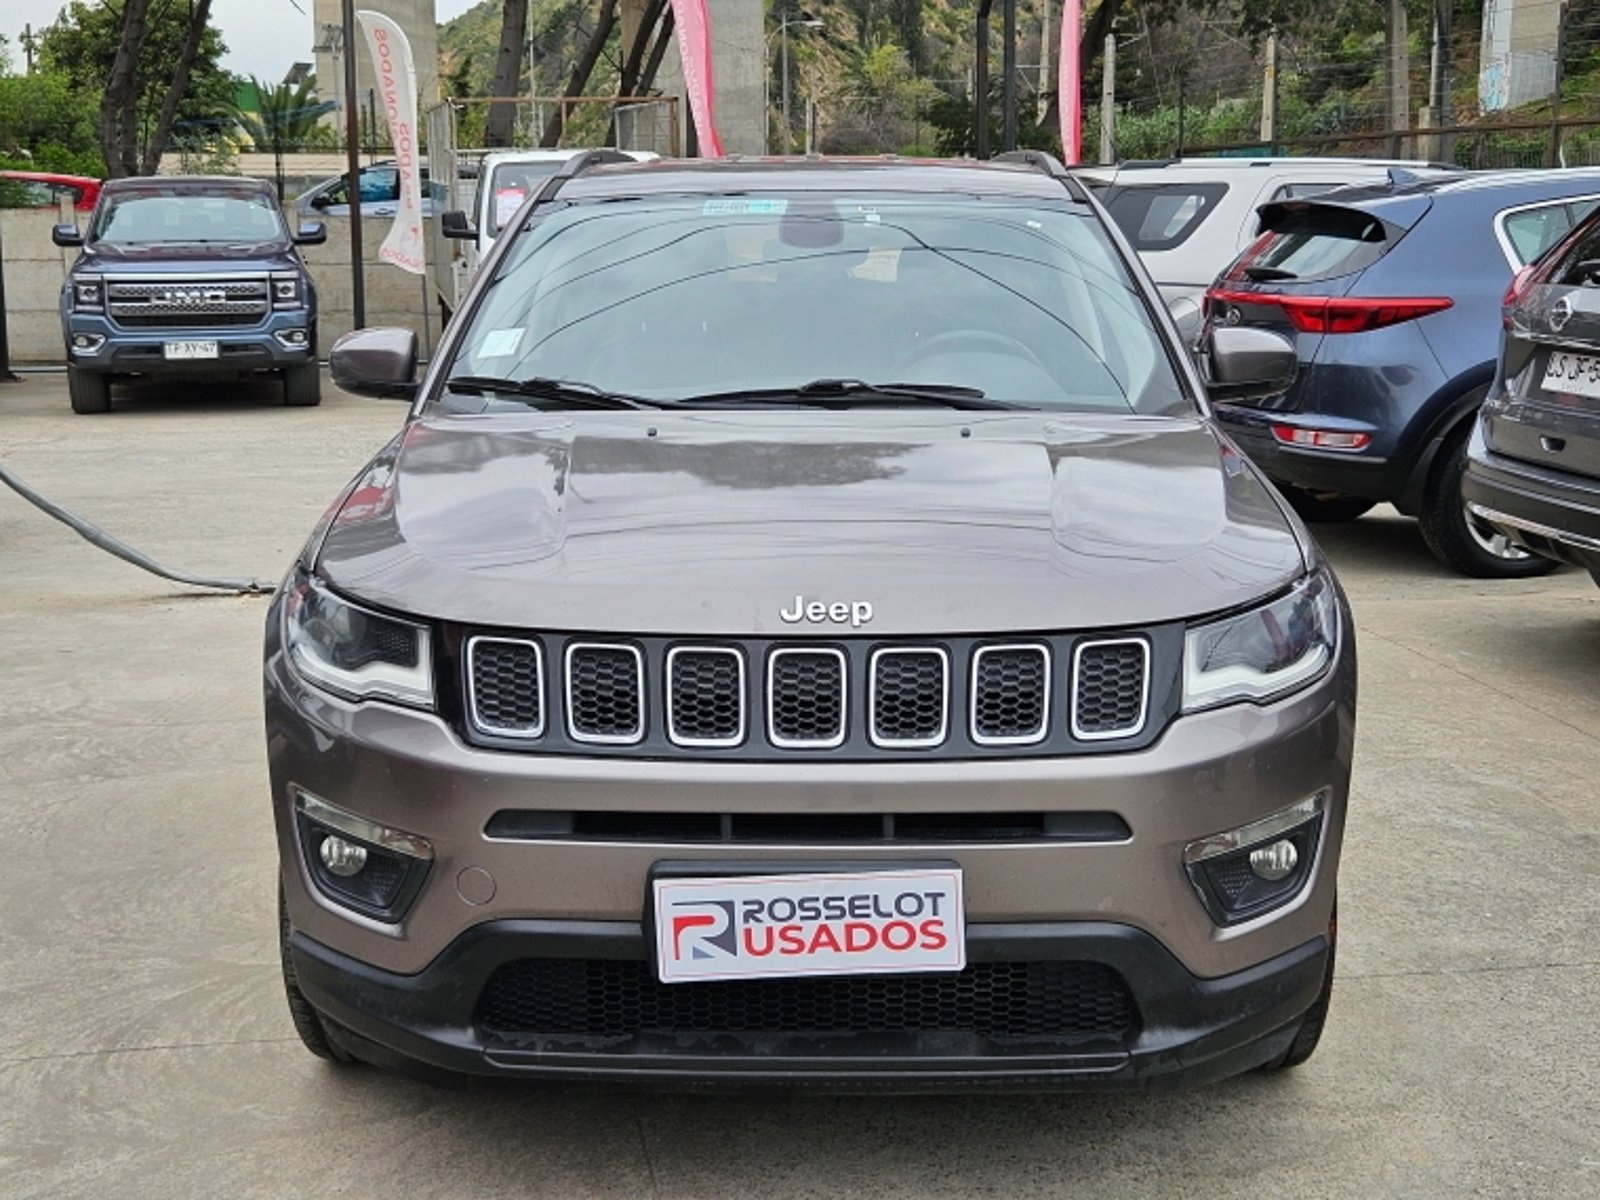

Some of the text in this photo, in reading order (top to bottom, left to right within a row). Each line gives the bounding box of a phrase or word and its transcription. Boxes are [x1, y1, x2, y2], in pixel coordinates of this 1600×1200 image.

[780, 595, 874, 628] Jeep
[742, 892, 945, 924] ROSSELOT
[743, 919, 947, 957] USADOS
